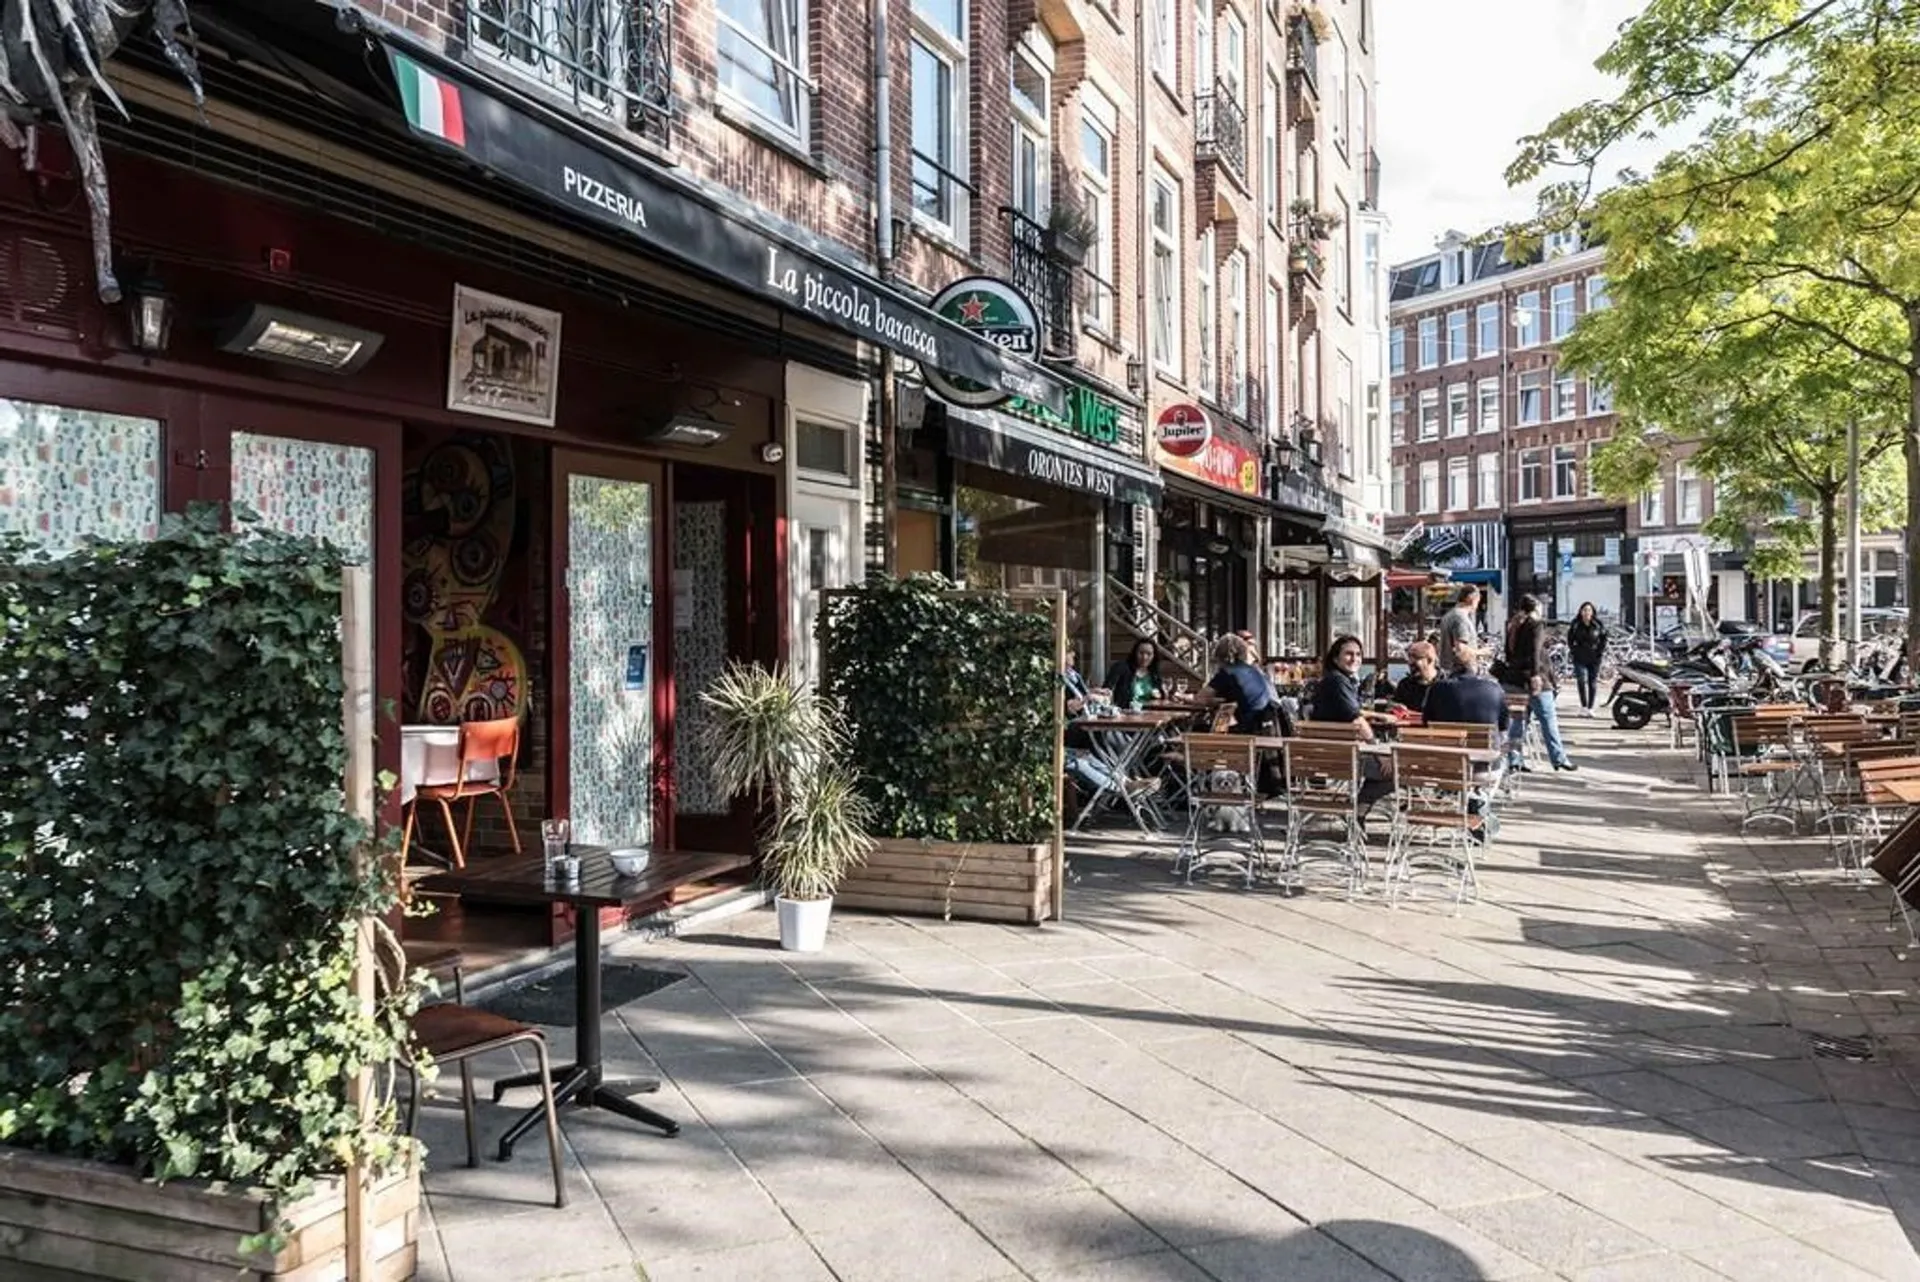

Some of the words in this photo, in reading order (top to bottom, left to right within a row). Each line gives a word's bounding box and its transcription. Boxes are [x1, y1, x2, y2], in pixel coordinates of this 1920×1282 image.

[564, 165, 647, 228] PIZZERIA
[766, 246, 798, 295] La
[803, 271, 872, 327] piccola
[875, 296, 938, 357] baracca
[1163, 425, 1202, 438] Jupiler
[1028, 449, 1083, 487] ORONTES
[1086, 466, 1116, 497] WEST
